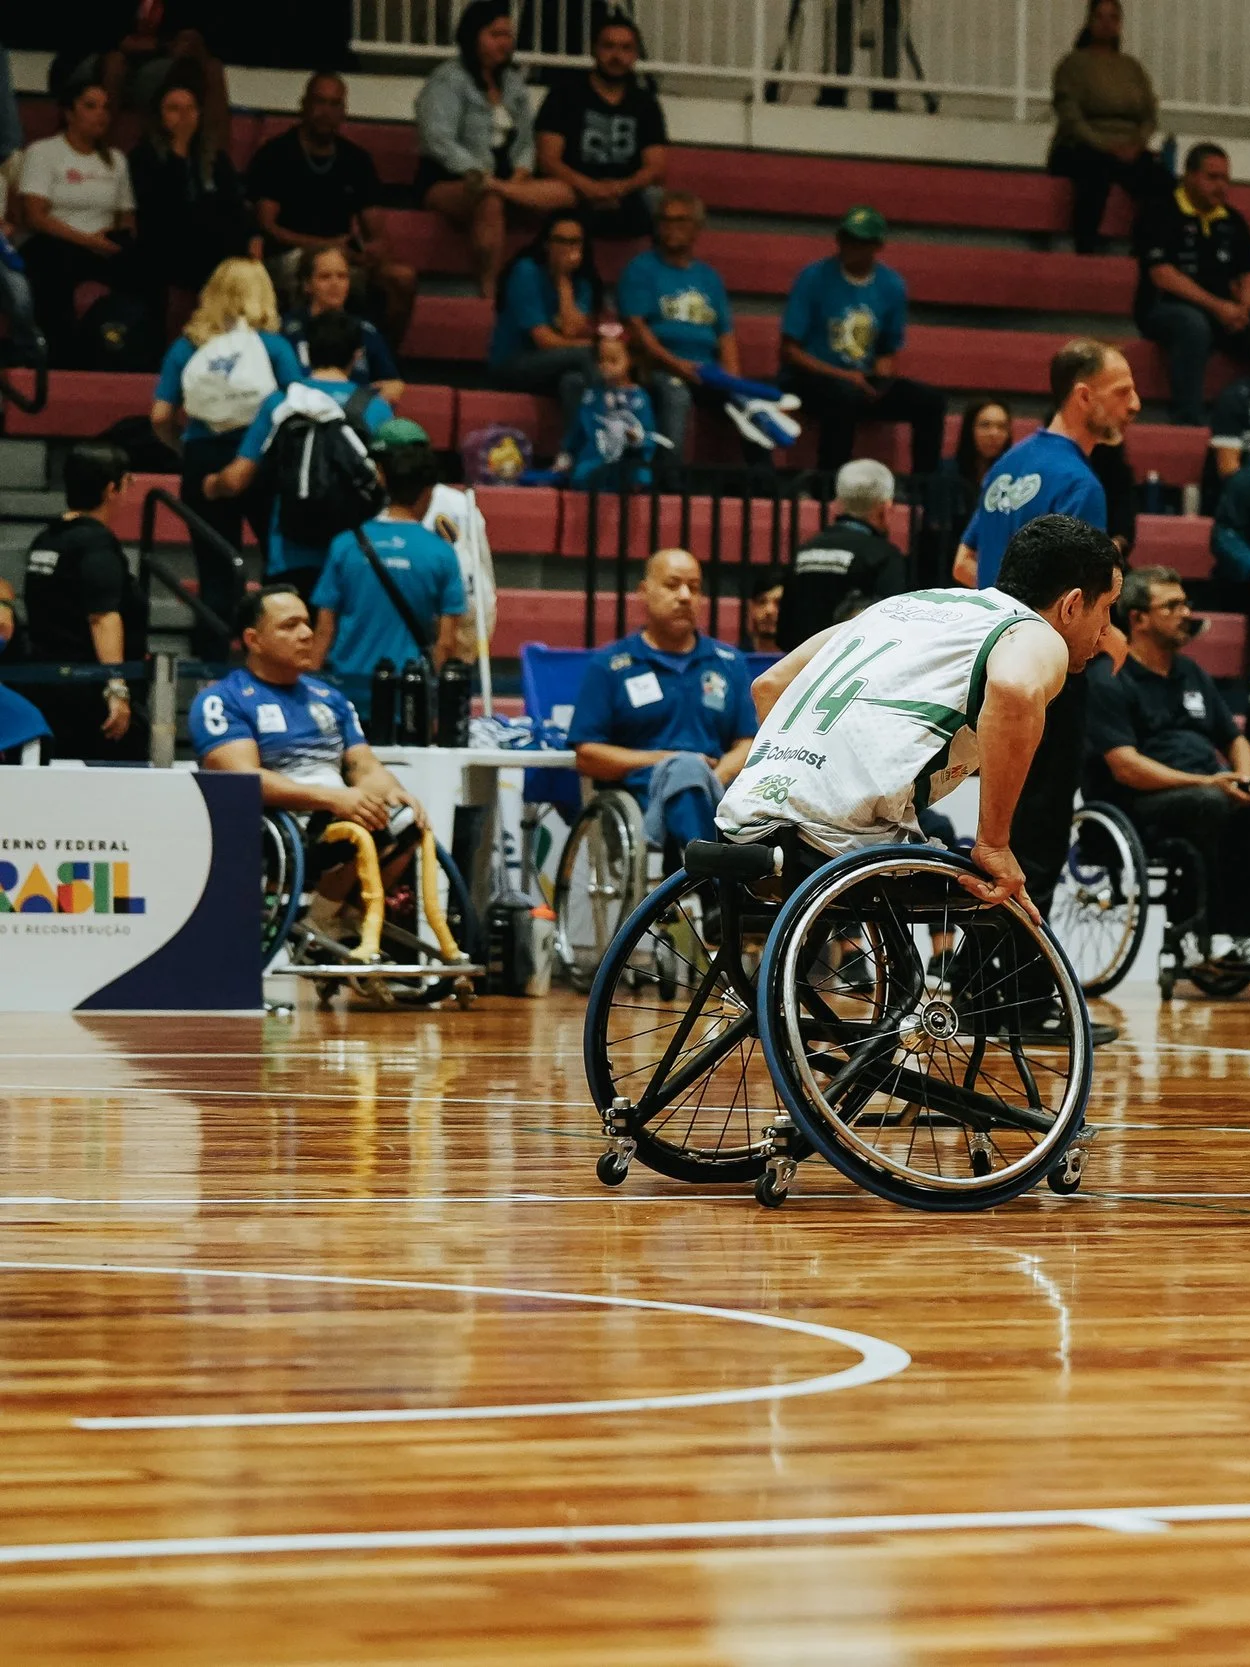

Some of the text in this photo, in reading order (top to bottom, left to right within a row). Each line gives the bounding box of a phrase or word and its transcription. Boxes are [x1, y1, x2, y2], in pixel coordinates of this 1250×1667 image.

[778, 635, 902, 735] 14
[203, 694, 229, 736] 8
[766, 745, 827, 770] Coloplast
[770, 774, 798, 788] GOV
[762, 784, 789, 805] GO
[55, 839, 130, 852] FEDERAL
[25, 923, 131, 937] RECONSTRUÇÃO
